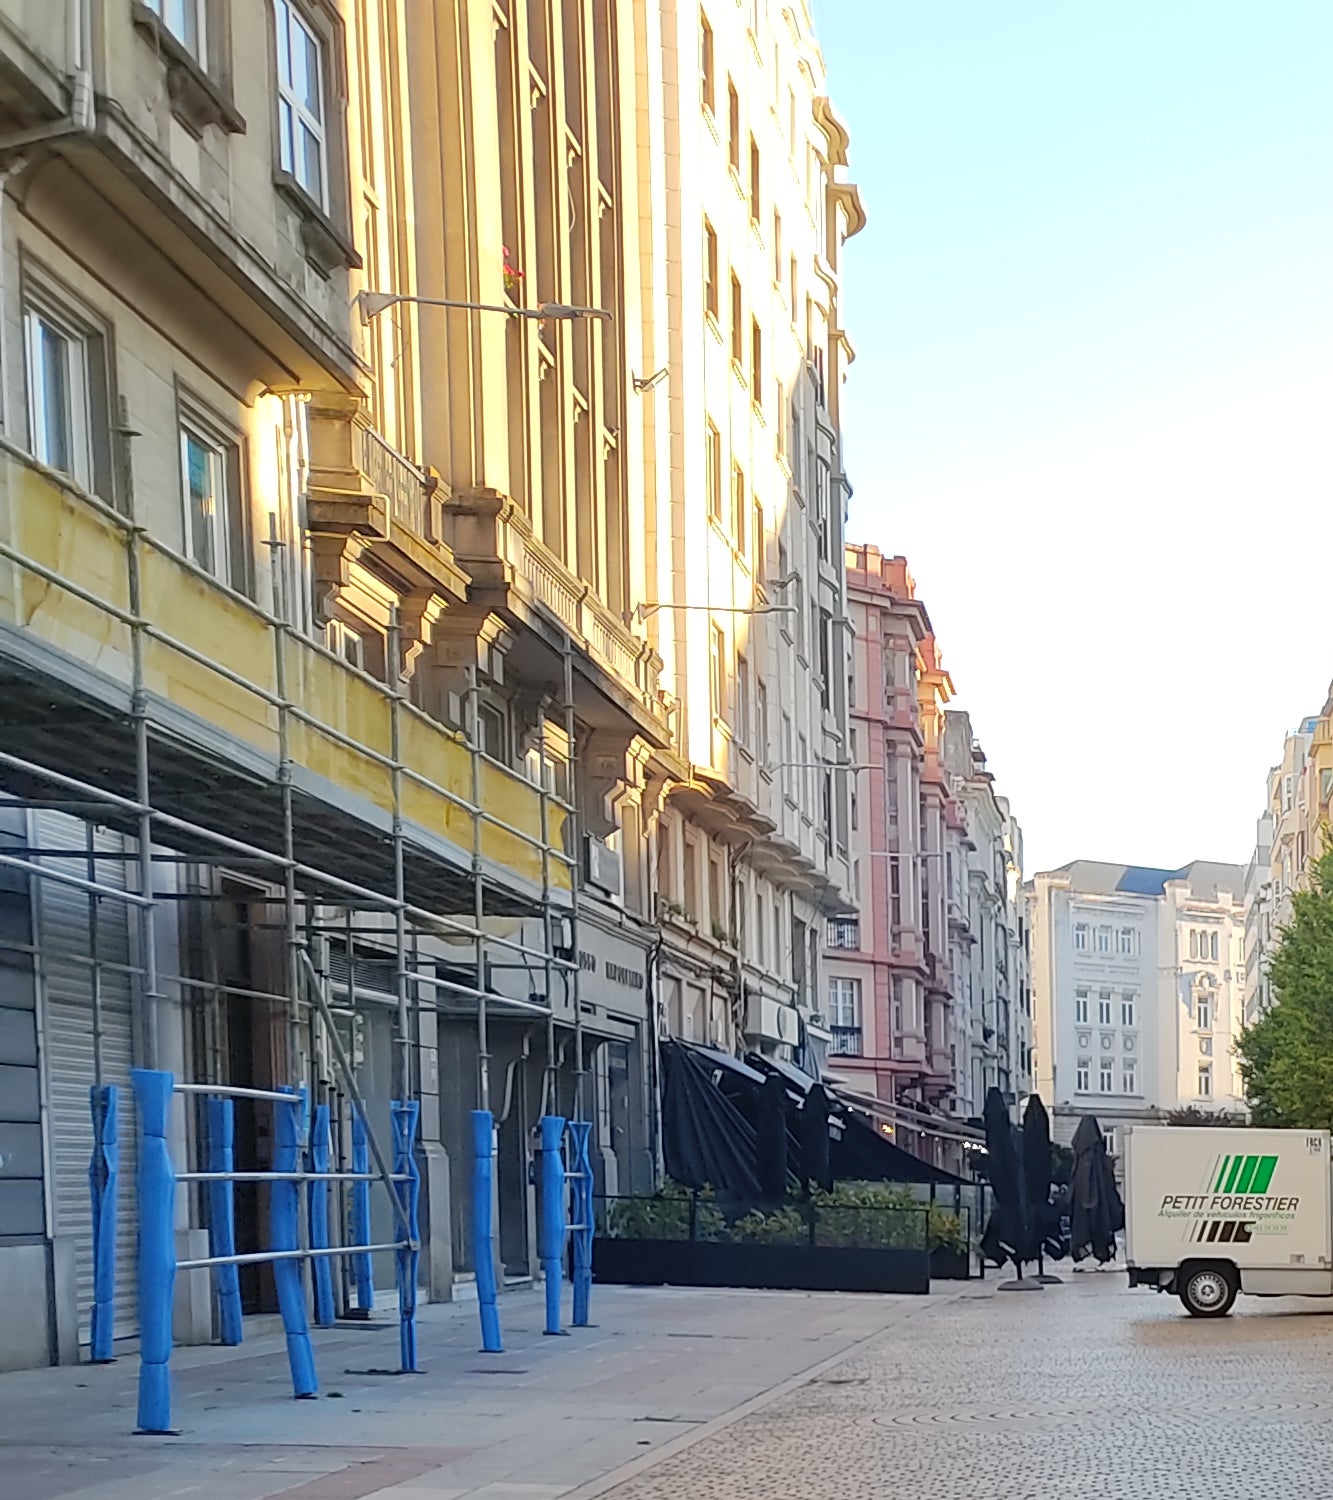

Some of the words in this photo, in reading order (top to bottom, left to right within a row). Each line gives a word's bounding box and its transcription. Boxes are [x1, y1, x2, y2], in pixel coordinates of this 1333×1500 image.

[1161, 1195, 1209, 1210] PETIT
[1209, 1196, 1300, 1212] FORESTIER
[1192, 1210, 1204, 1218] de
